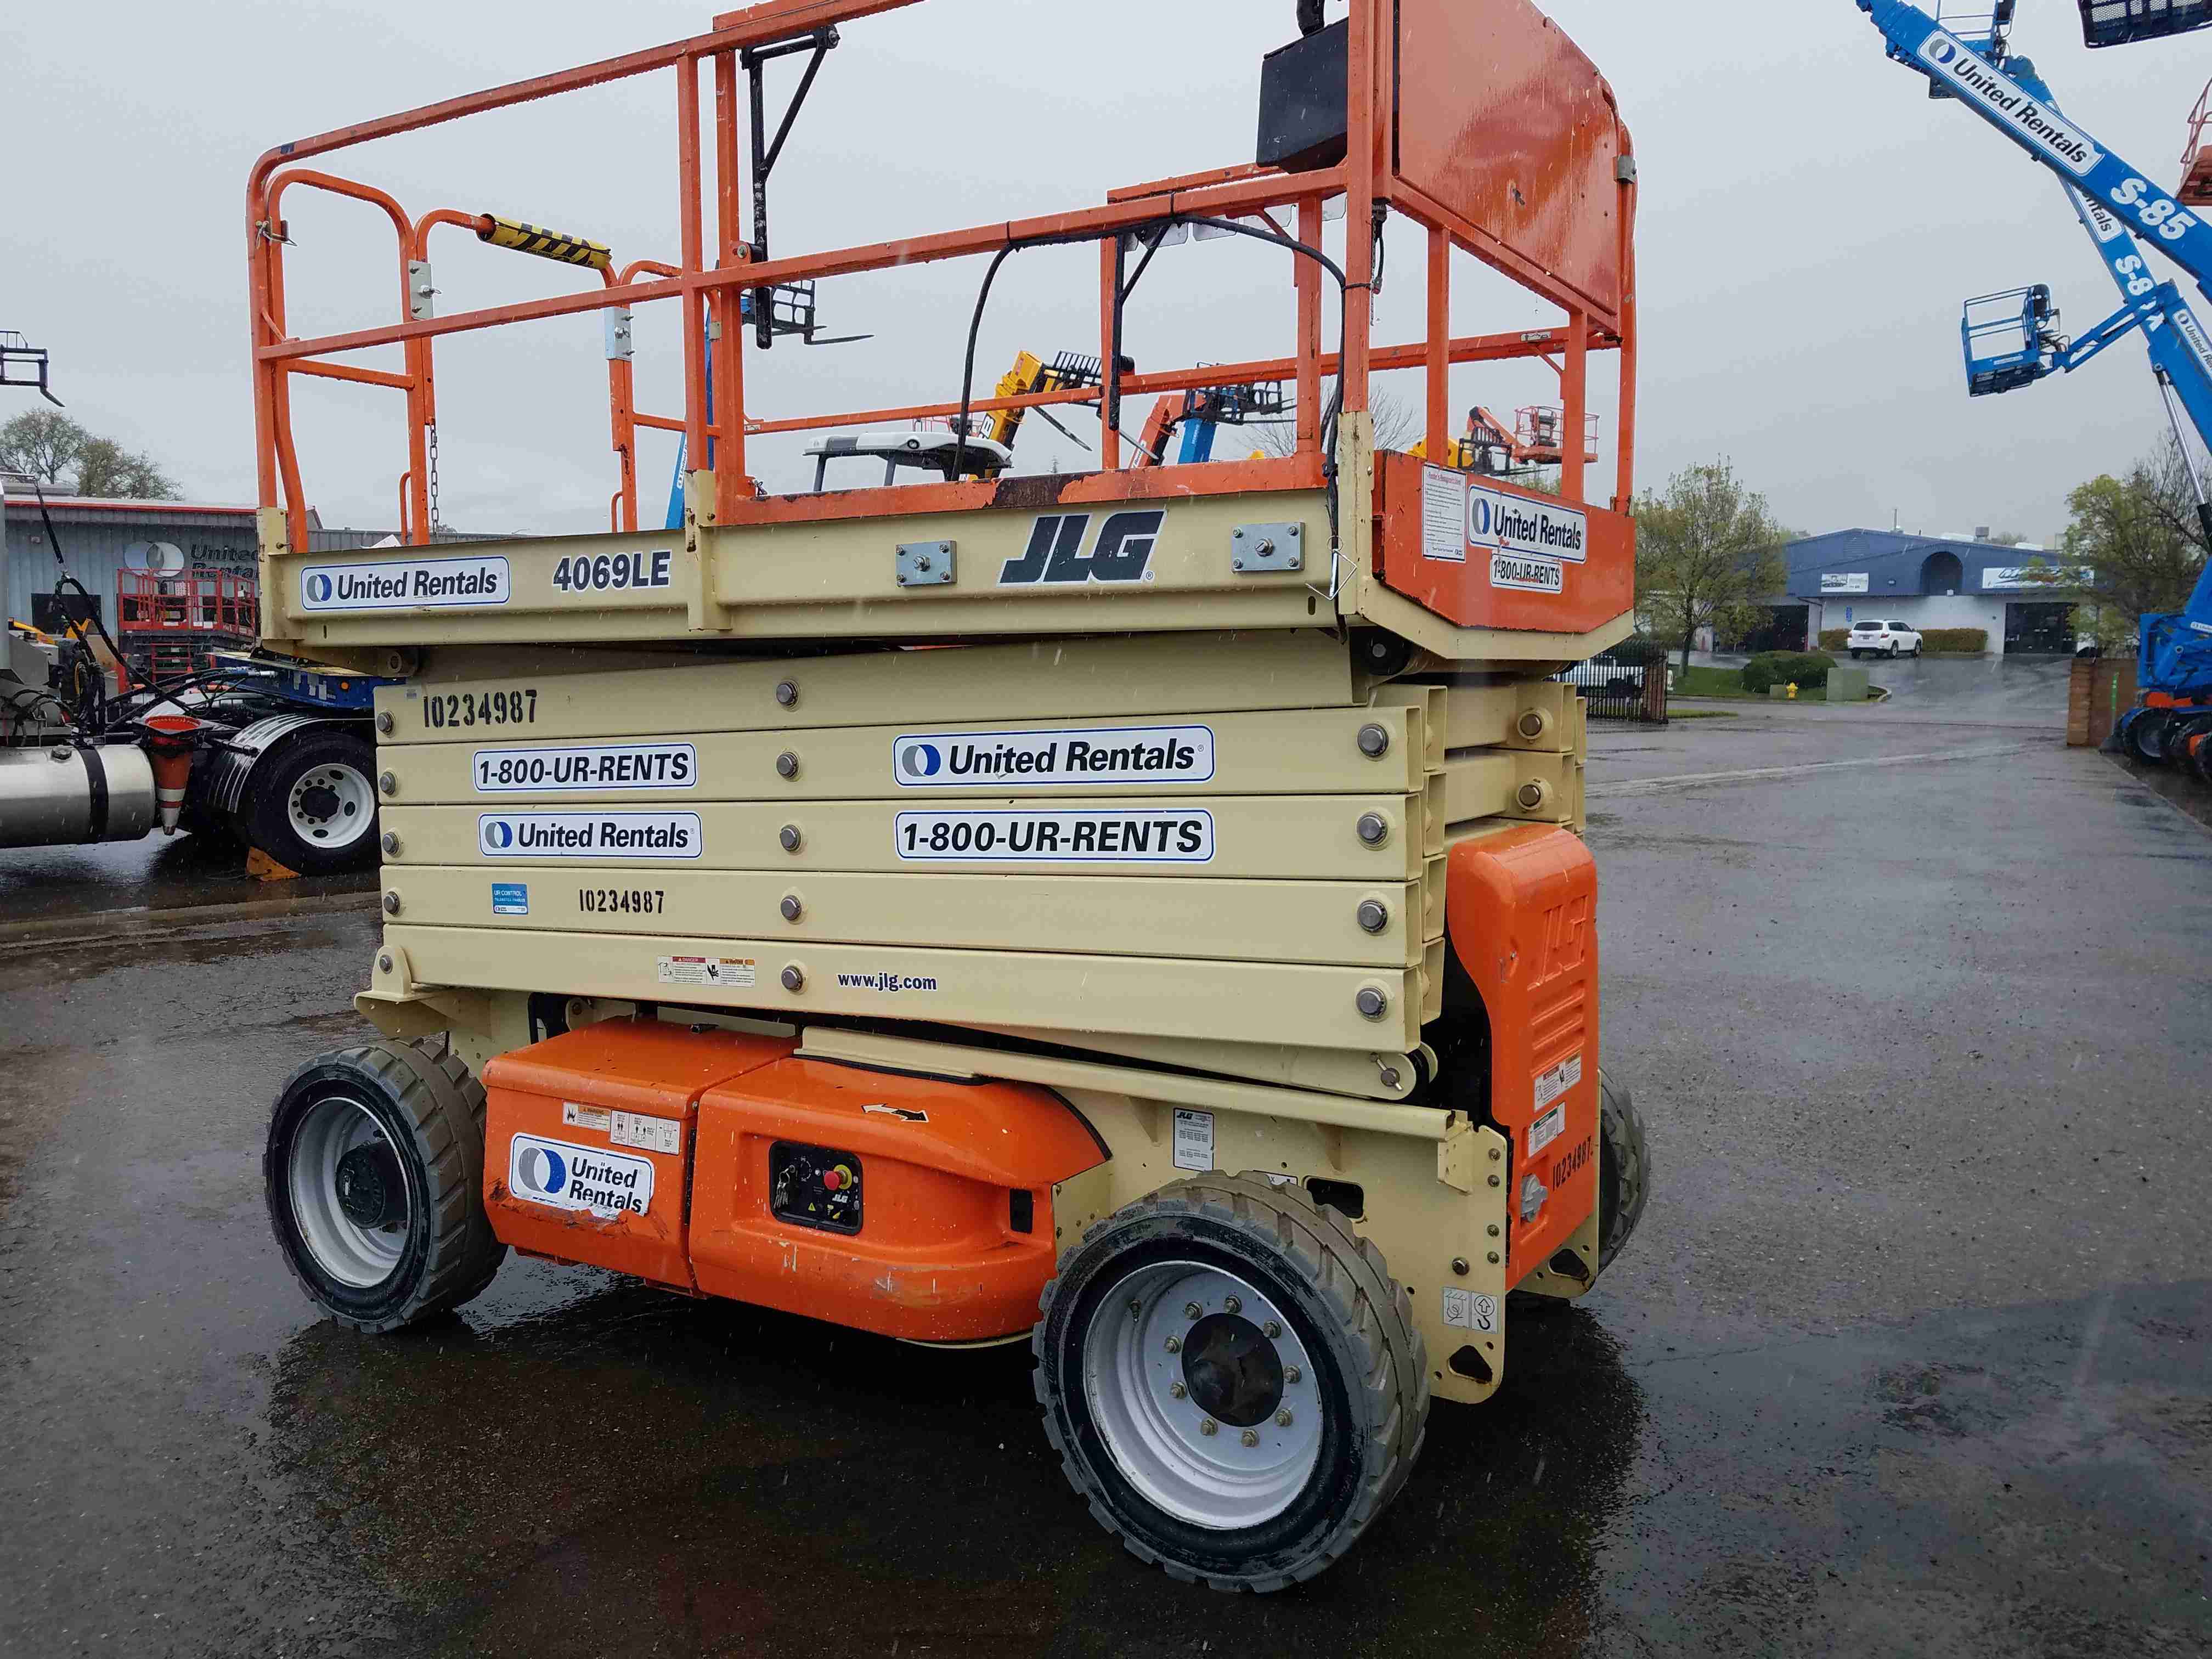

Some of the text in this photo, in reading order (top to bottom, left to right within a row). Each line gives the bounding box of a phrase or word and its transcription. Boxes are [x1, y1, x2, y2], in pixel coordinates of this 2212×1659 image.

[1953, 58, 2087, 163] United Rentals
[2111, 178, 2197, 240] S-85
[2185, 325, 2208, 353] United
[1494, 504, 1537, 542] United
[1540, 515, 1582, 550] Rentals
[999, 511, 1166, 583] JLG
[192, 562, 258, 578] Renta
[338, 567, 497, 599] United Rentals
[553, 551, 670, 591] 4069LE
[1494, 560, 1560, 585] 1-800-UR-RENTS
[480, 753, 689, 783] 1-800-UR-RENTS
[950, 738, 1194, 774] United Rentals
[518, 822, 689, 848] United Rentals
[904, 821, 1202, 853] 1-800-UR-RENTS
[838, 973, 936, 990] www.jlg.com
[572, 1156, 638, 1189] United
[569, 1180, 643, 1213] Rentals
[832, 1193, 848, 1204] JLG
